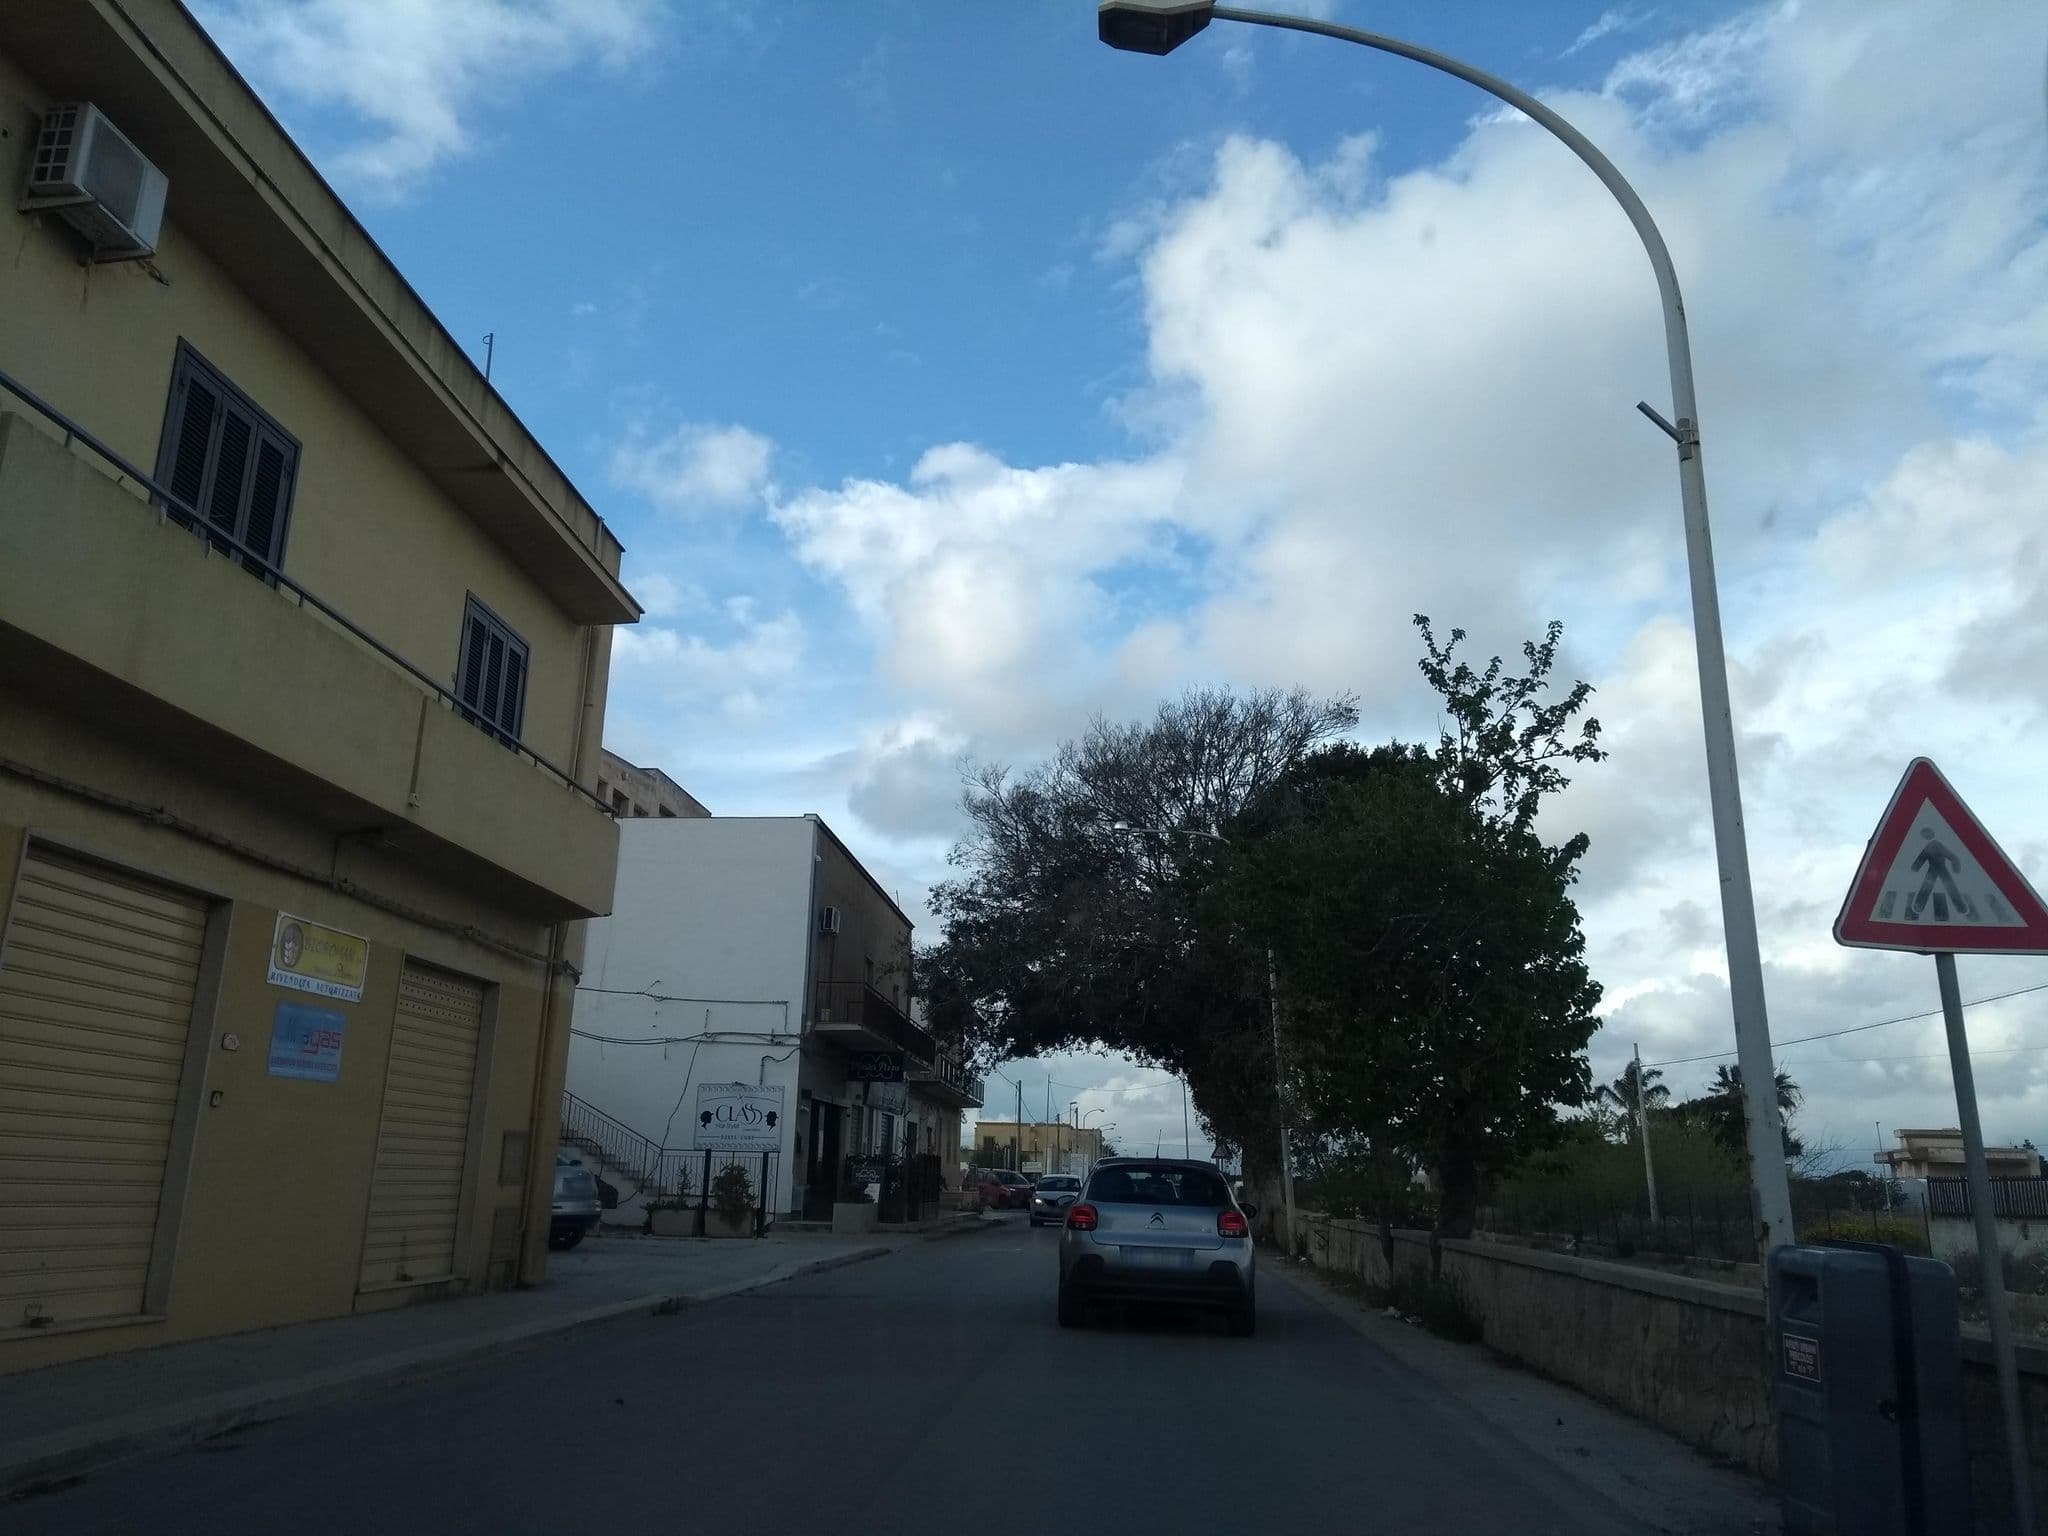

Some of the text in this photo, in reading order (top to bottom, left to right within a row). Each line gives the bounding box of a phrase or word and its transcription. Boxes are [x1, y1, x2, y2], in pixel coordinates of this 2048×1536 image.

[270, 971, 310, 989] RIVENDITA
[316, 982, 361, 999] AUTORIZZATA
[715, 1103, 763, 1125] CLASS
